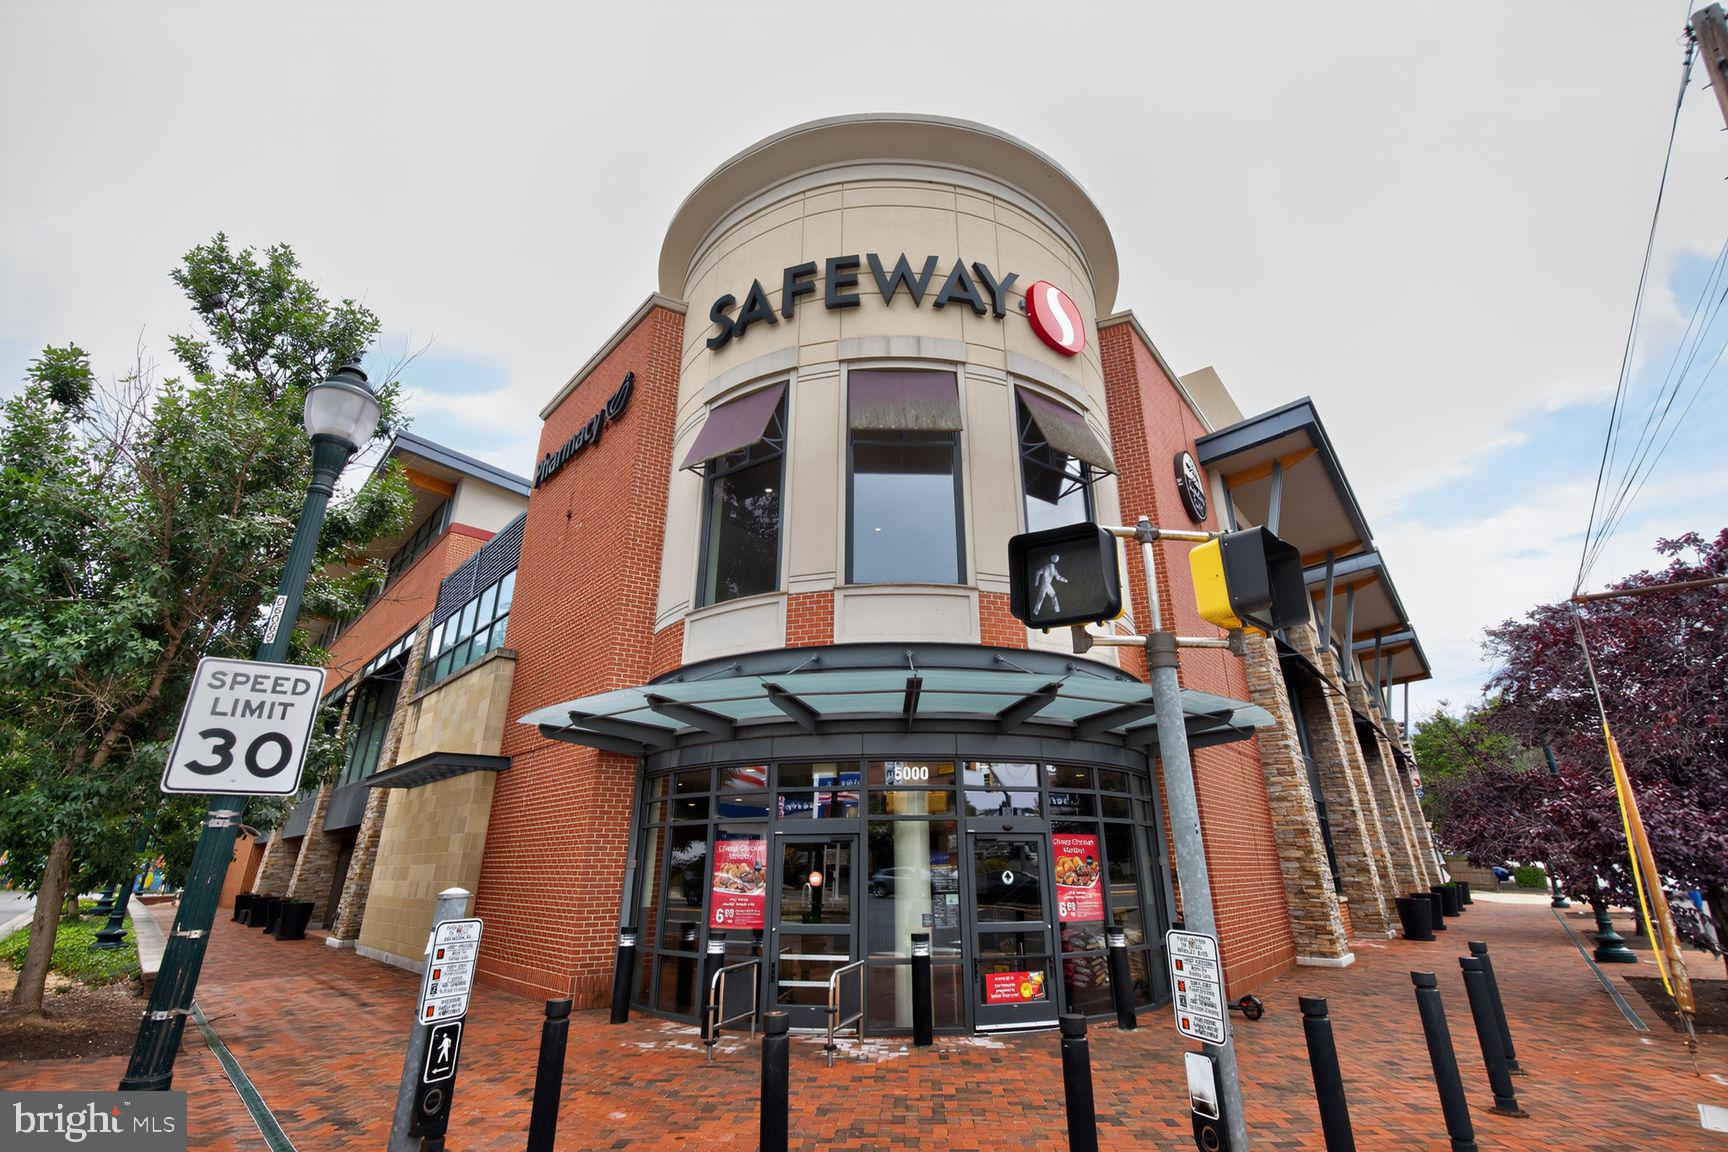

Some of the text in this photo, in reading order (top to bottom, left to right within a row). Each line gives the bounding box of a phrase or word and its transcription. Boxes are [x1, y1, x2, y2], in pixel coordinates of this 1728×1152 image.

[706, 252, 1020, 350] SAFEWAY
[206, 670, 311, 696] SPEED
[209, 697, 295, 721] LIMIT
[184, 727, 293, 778] 30
[894, 766, 929, 781] 5000
